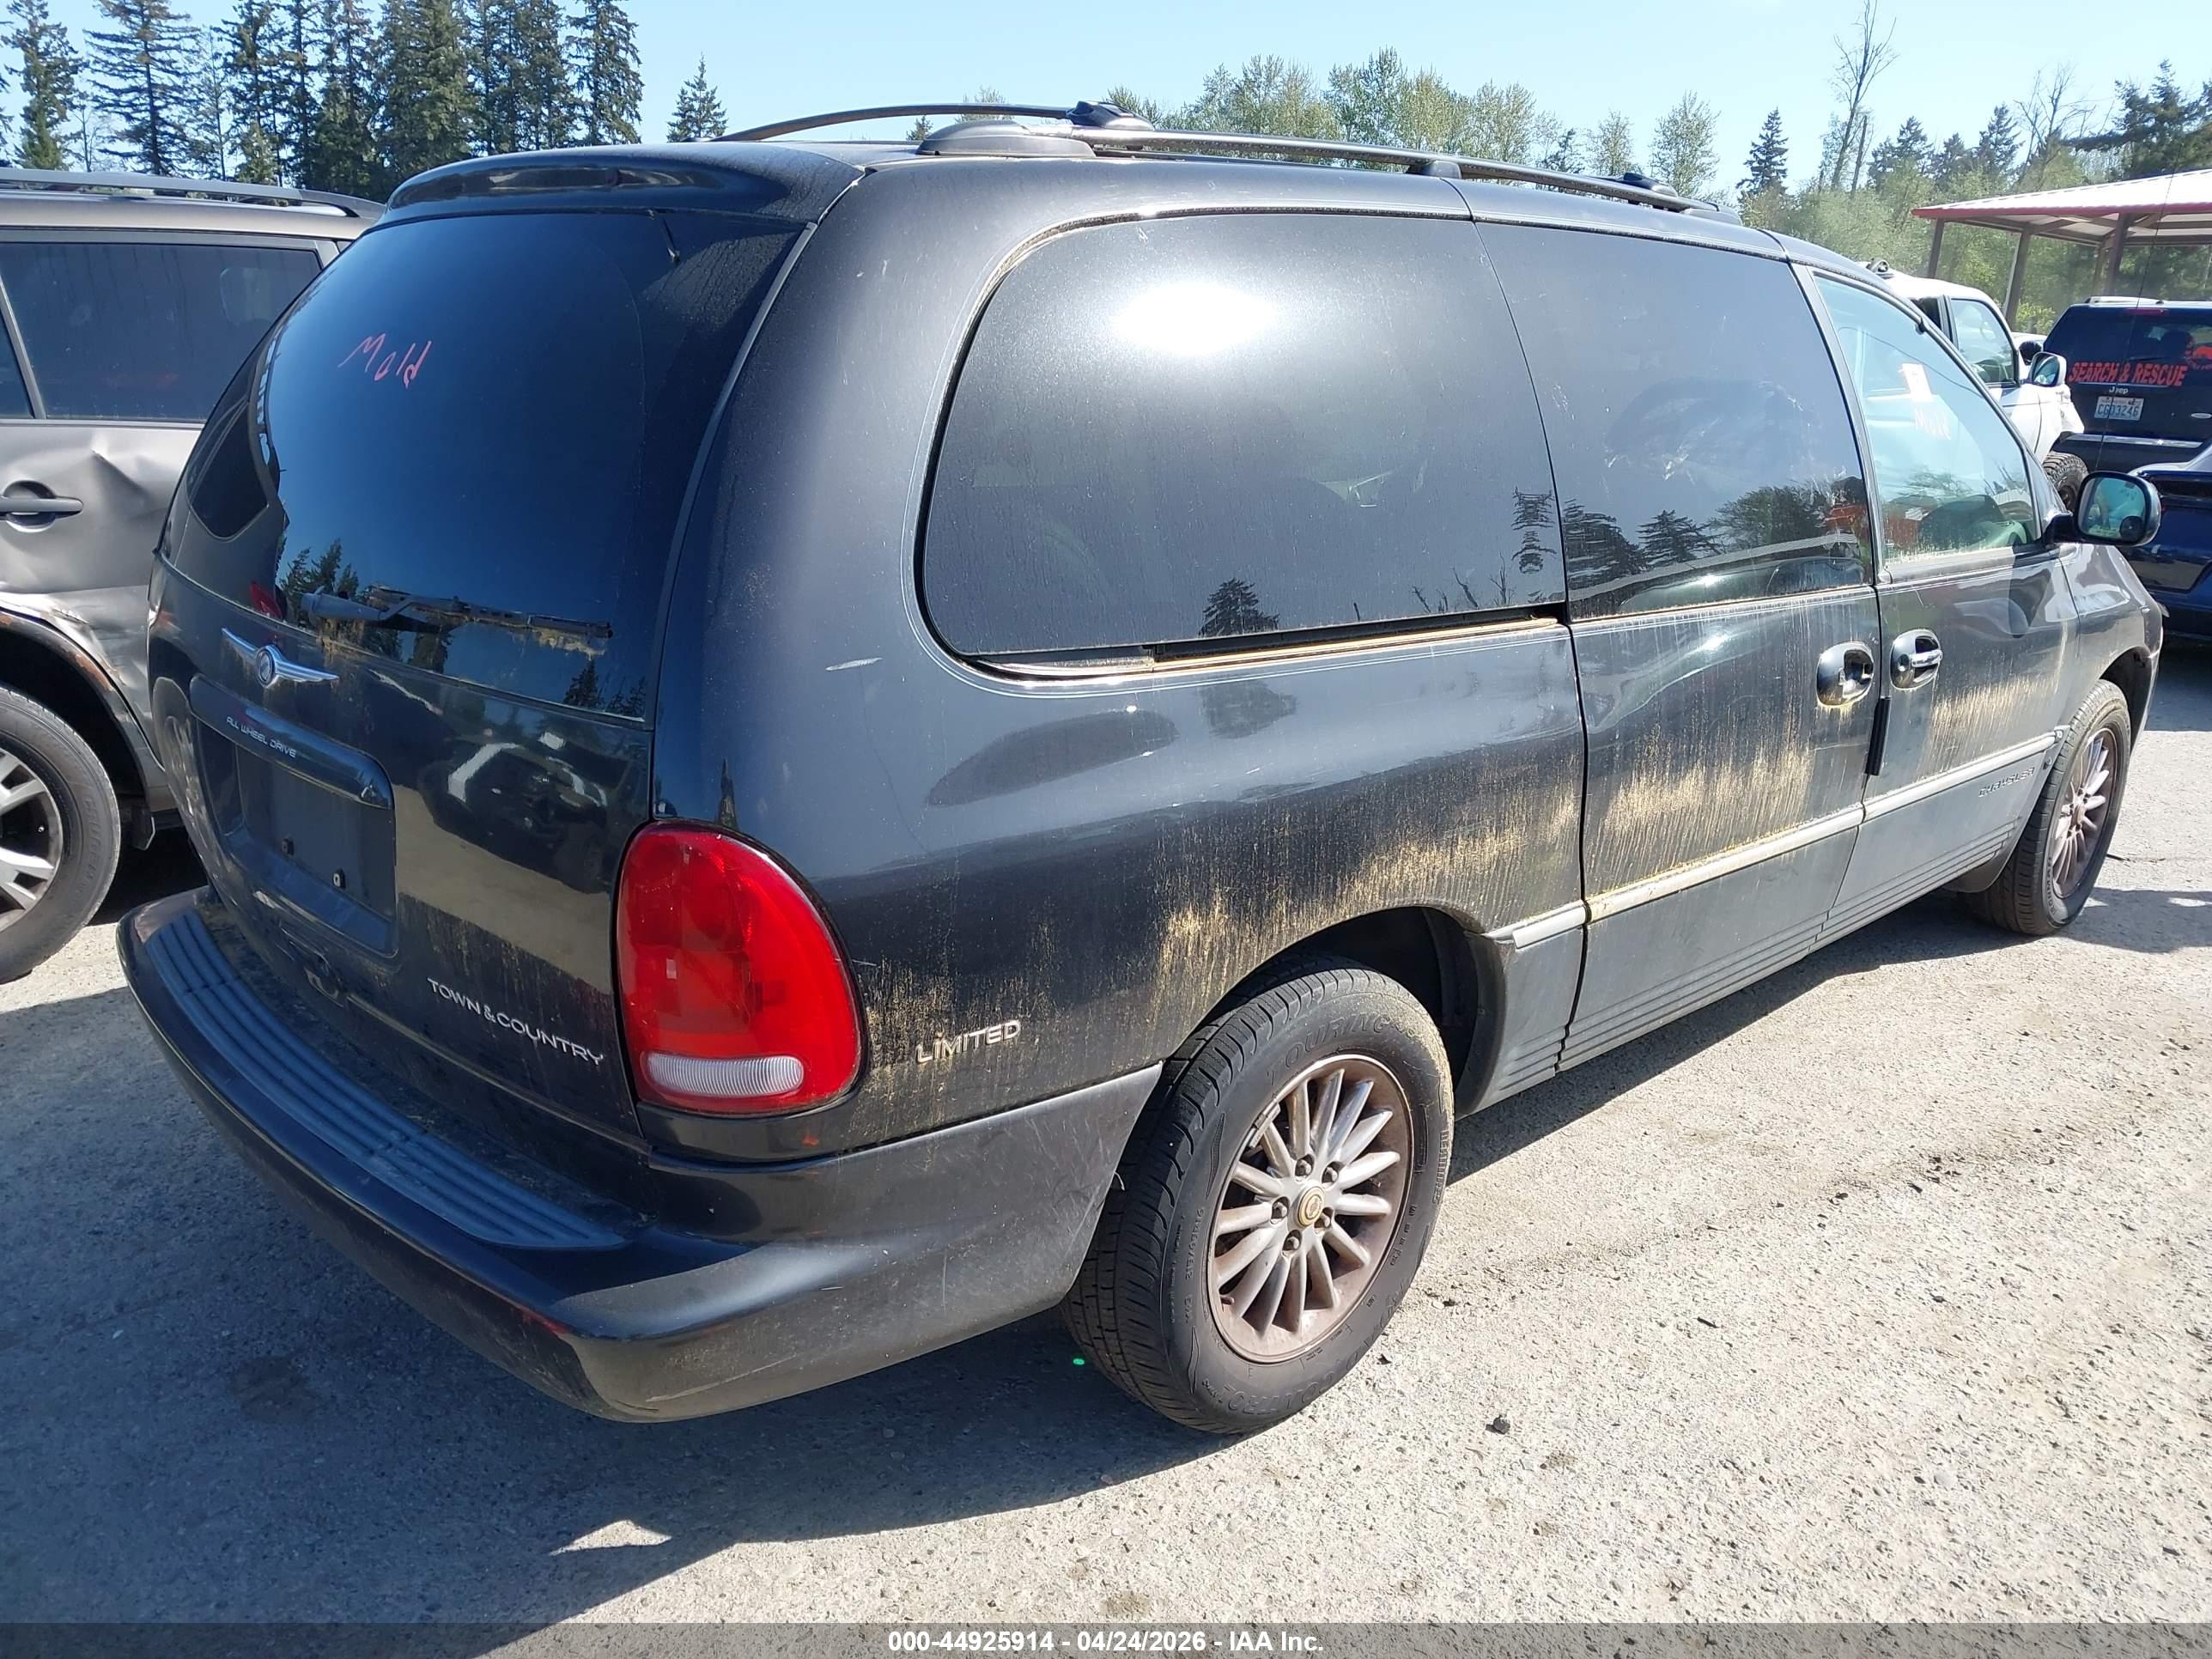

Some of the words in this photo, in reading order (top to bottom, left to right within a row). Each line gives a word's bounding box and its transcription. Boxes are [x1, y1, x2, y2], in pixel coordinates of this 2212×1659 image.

[2069, 362, 2118, 383] SEARCH
[2118, 362, 2131, 383] &
[2130, 362, 2189, 387] RESCUE
[240, 724, 268, 745] WHEEL
[269, 738, 297, 758] DRIVE
[916, 1020, 1022, 1064] LIMITED
